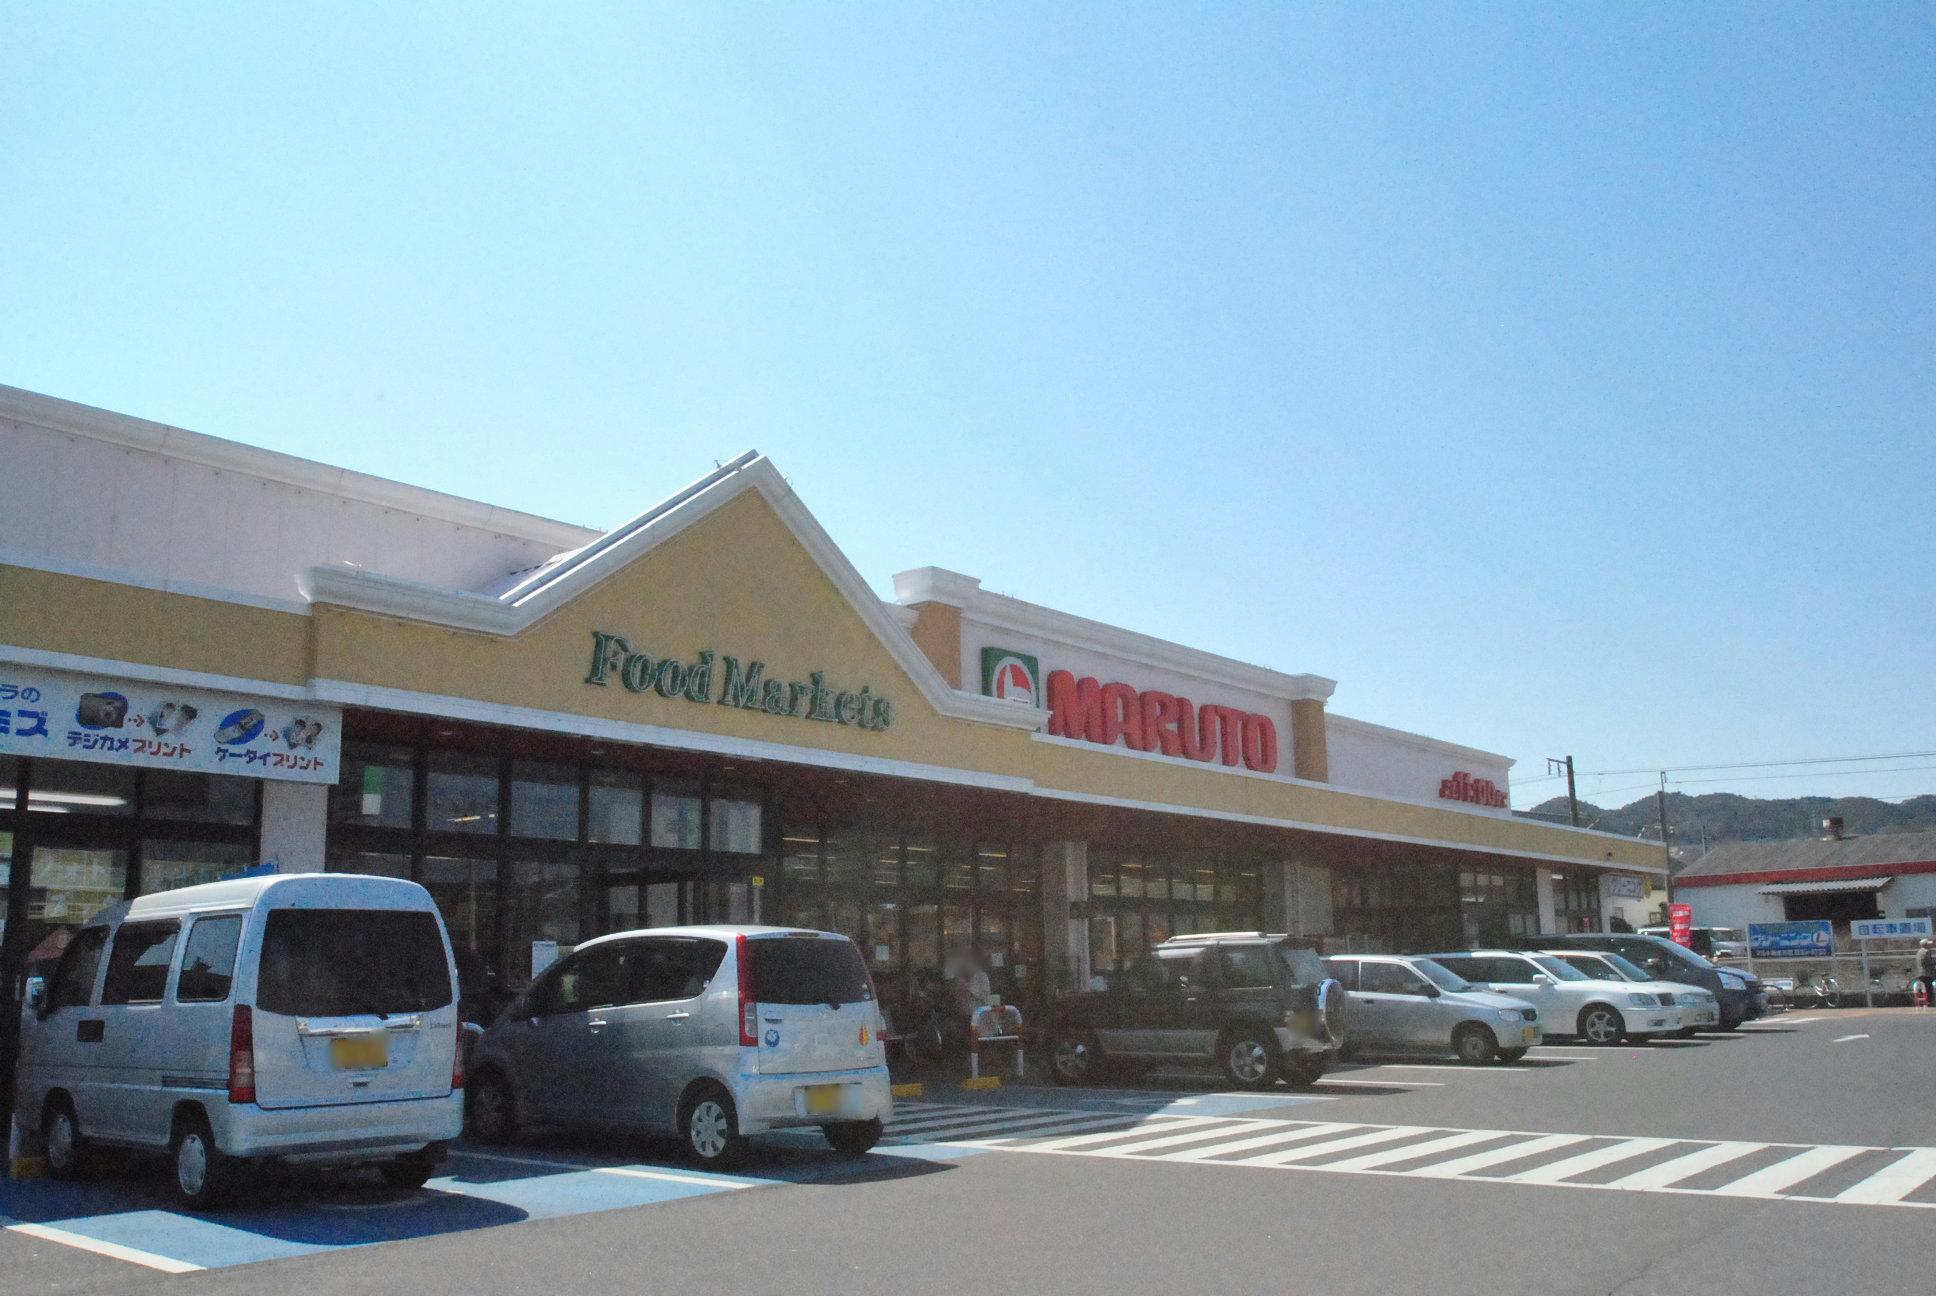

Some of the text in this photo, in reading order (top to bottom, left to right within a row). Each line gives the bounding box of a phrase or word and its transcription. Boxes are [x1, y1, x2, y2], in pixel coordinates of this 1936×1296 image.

[585, 631, 895, 732] Food Markets
[66, 730, 193, 758] デジカメプリント
[1047, 670, 1277, 773] MARUTO
[215, 747, 325, 771] ケータイプリント
